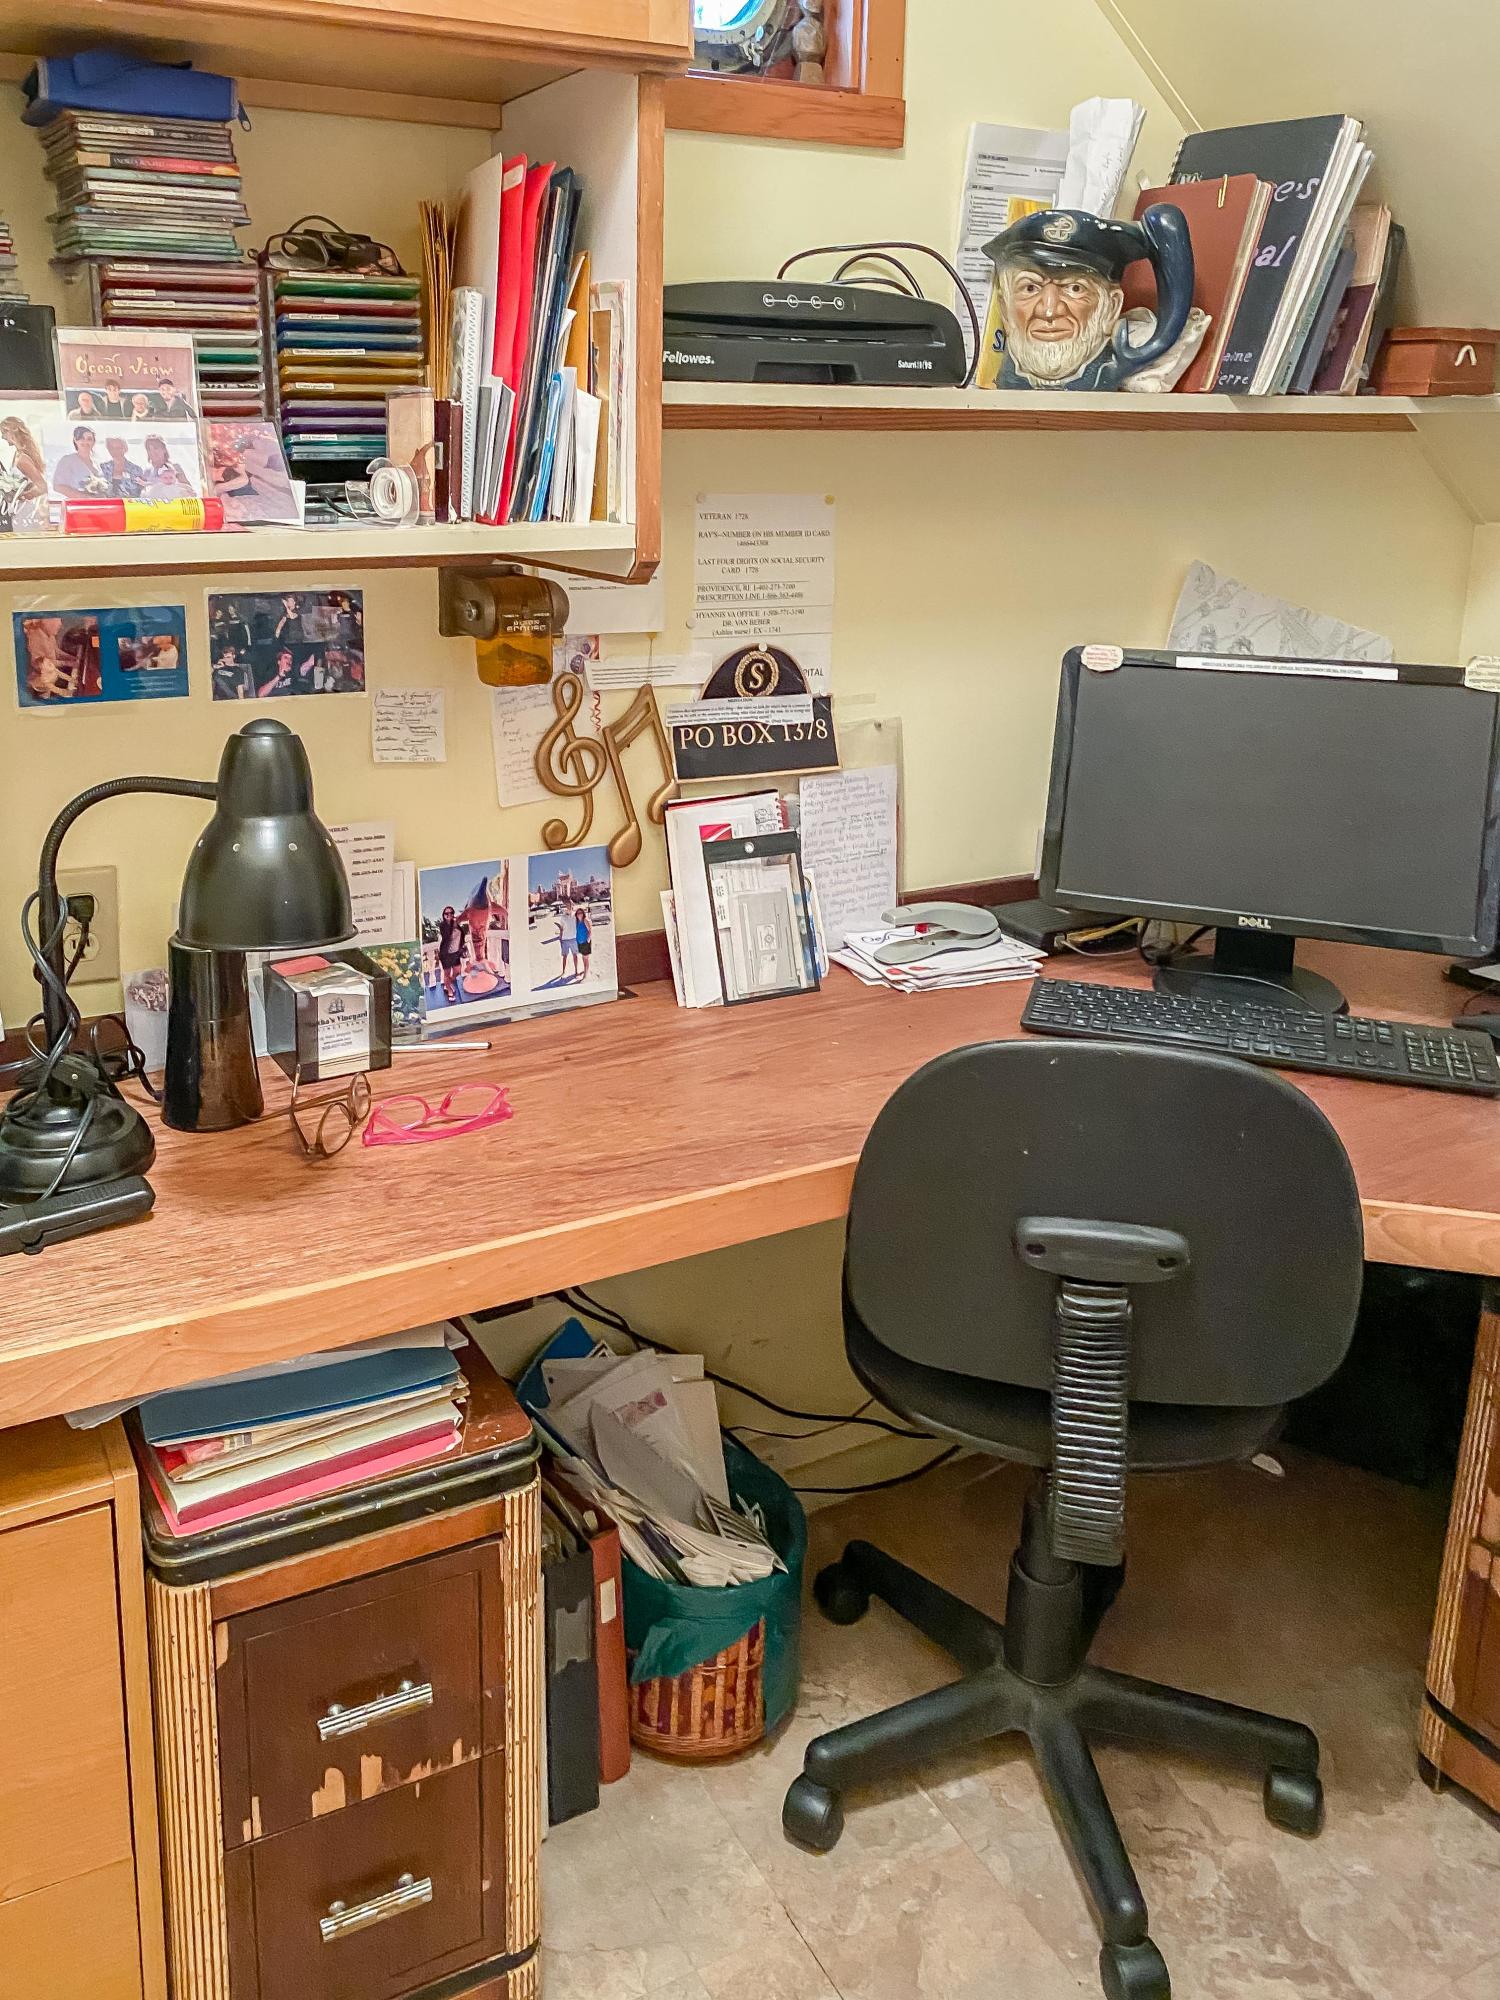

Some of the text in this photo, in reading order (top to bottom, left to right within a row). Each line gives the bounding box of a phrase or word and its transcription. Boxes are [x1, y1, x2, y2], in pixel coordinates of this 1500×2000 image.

[1273, 177, 1320, 202] e's
[1254, 235, 1297, 267] al
[75, 355, 174, 377] Ocean View
[699, 512, 732, 520] VETERAN
[749, 662, 765, 689] S
[679, 726, 715, 750] PO
[721, 722, 776, 748] BOX
[1238, 915, 1272, 930] DELL
